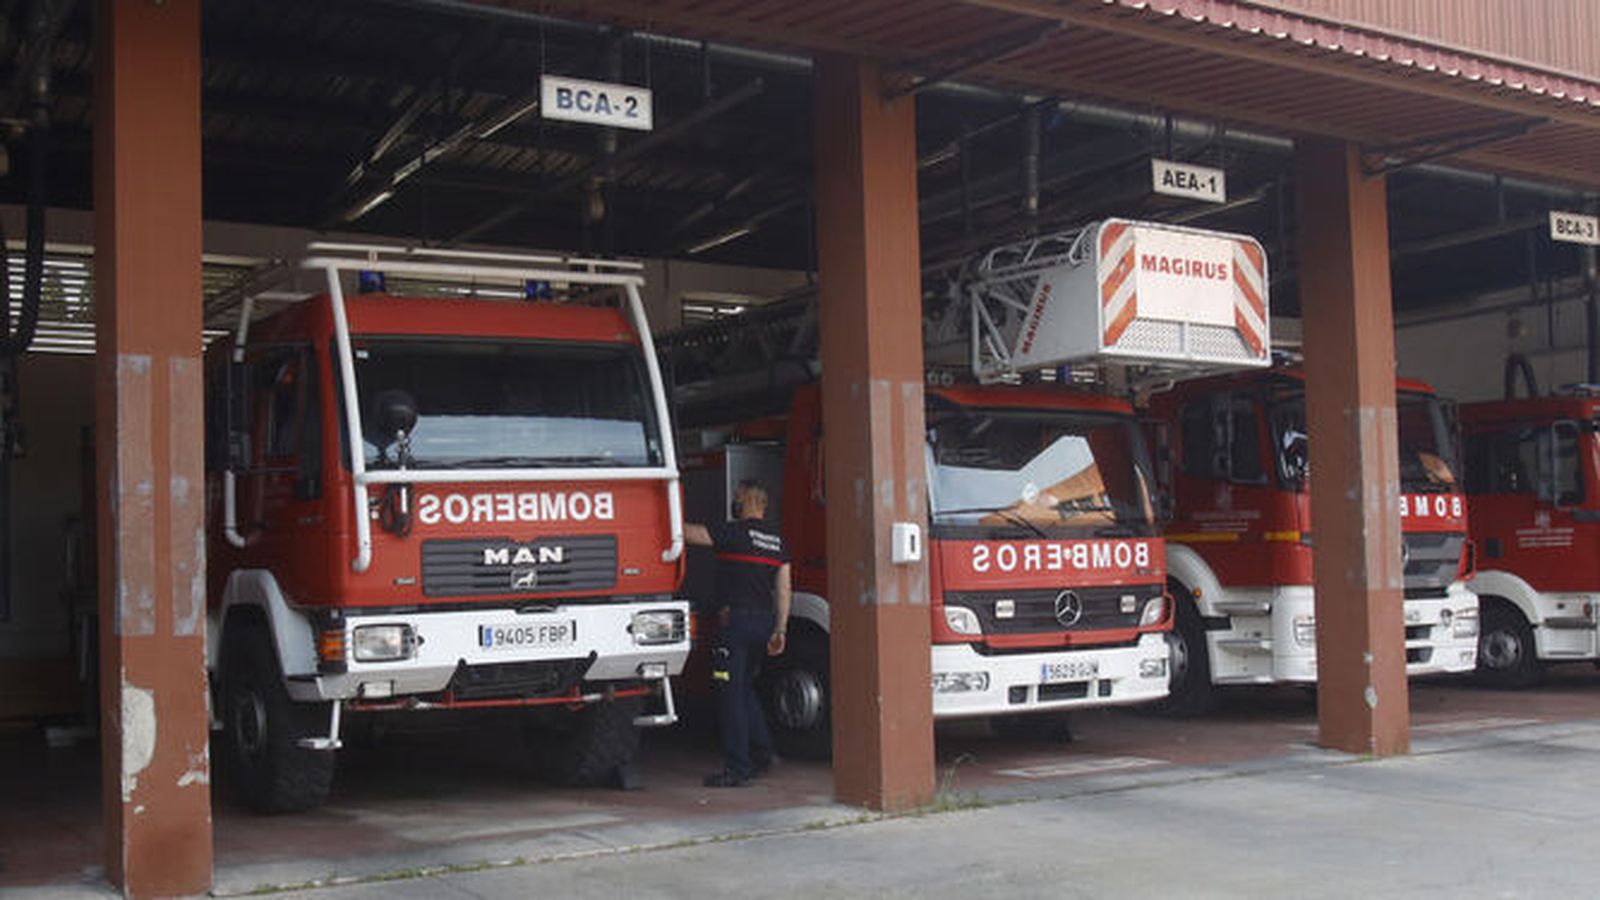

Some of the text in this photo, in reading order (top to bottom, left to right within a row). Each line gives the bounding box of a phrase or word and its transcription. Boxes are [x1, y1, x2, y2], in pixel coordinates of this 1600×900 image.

[556, 87, 638, 118] BCA-2
[1162, 169, 1216, 194] AEA-1
[1141, 254, 1228, 281] MAGIRUS
[484, 546, 563, 565] MAN
[495, 625, 568, 646] 9405 FBP
